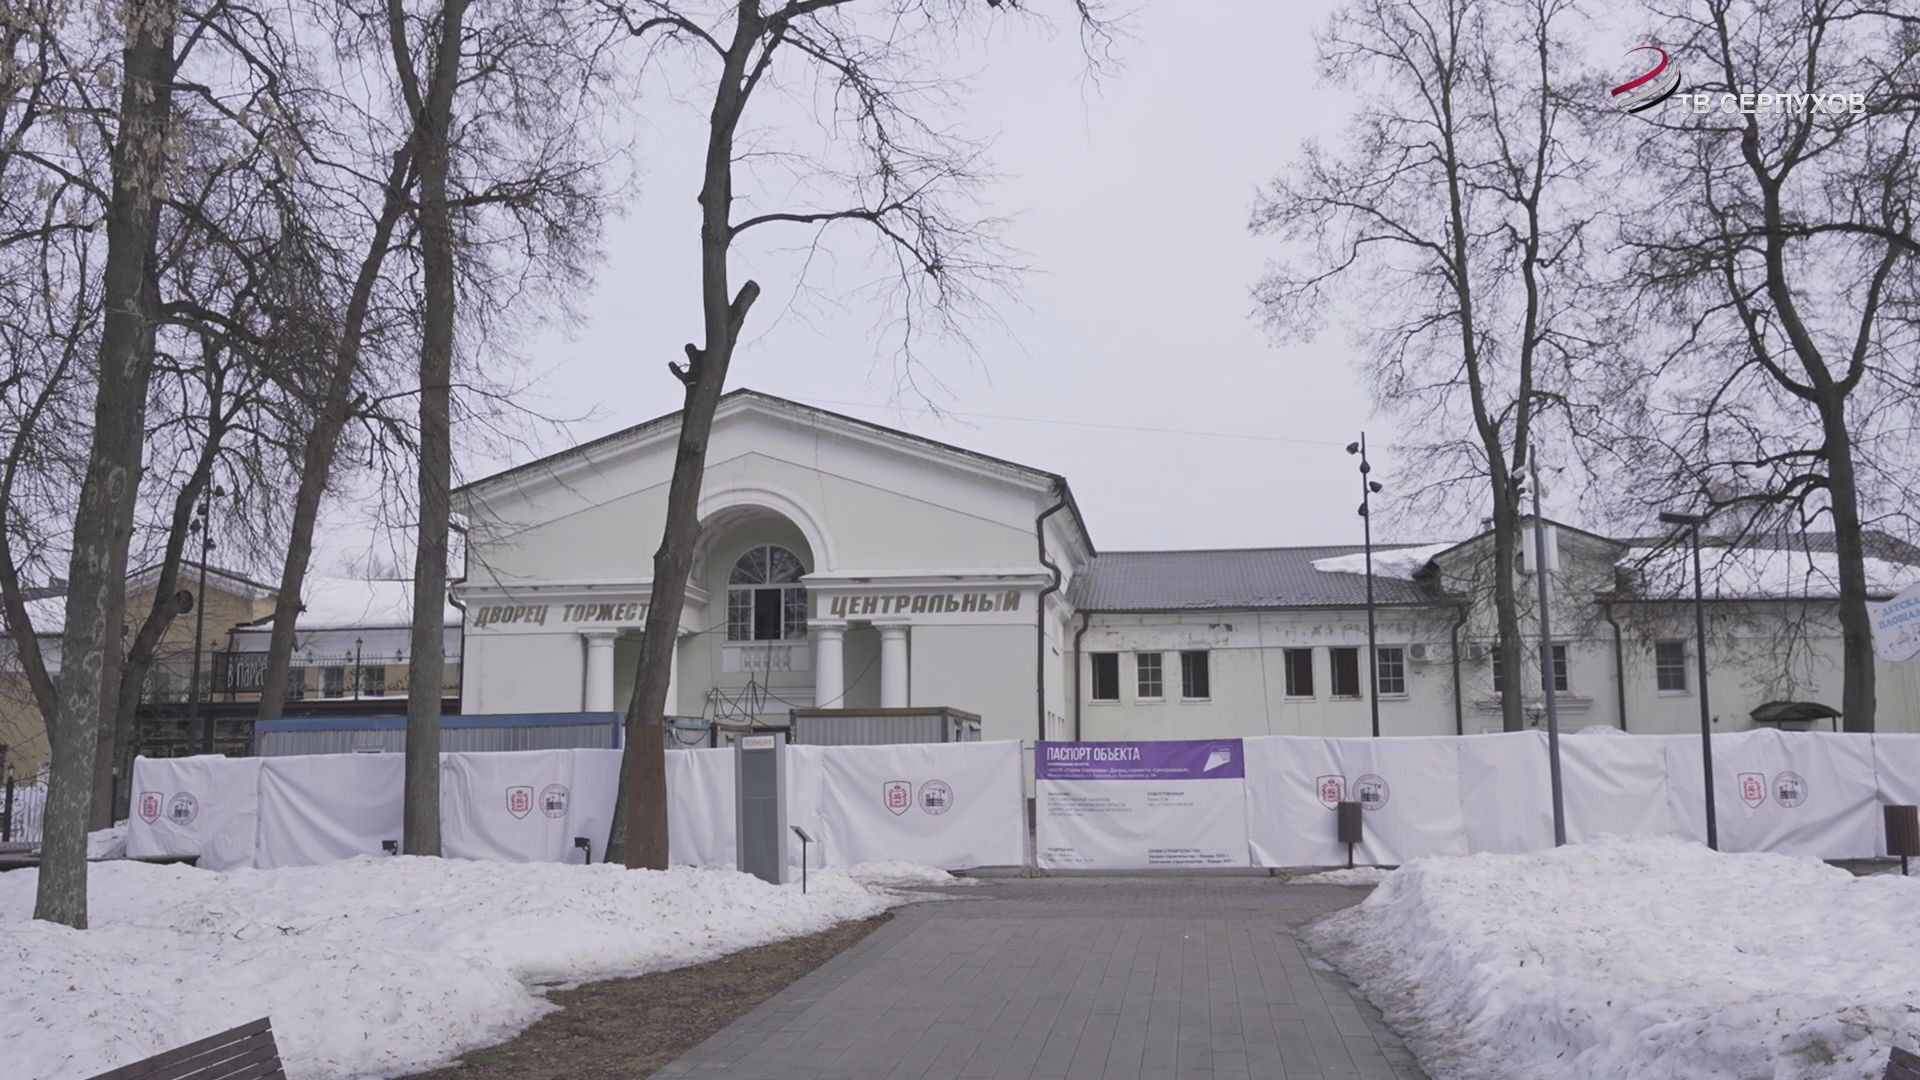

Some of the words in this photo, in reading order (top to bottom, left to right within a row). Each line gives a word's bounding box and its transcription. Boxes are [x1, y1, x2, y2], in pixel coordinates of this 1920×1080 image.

[474, 604, 549, 627] ДВОРЕЦ
[562, 602, 650, 622] ТОРЖЕСТ
[830, 590, 1021, 618] ЦЕНТРАЛЬНЫЙ
[1046, 747, 1092, 761] ПАСПОРТ
[1093, 747, 1141, 761] ОБЪЕКТА
